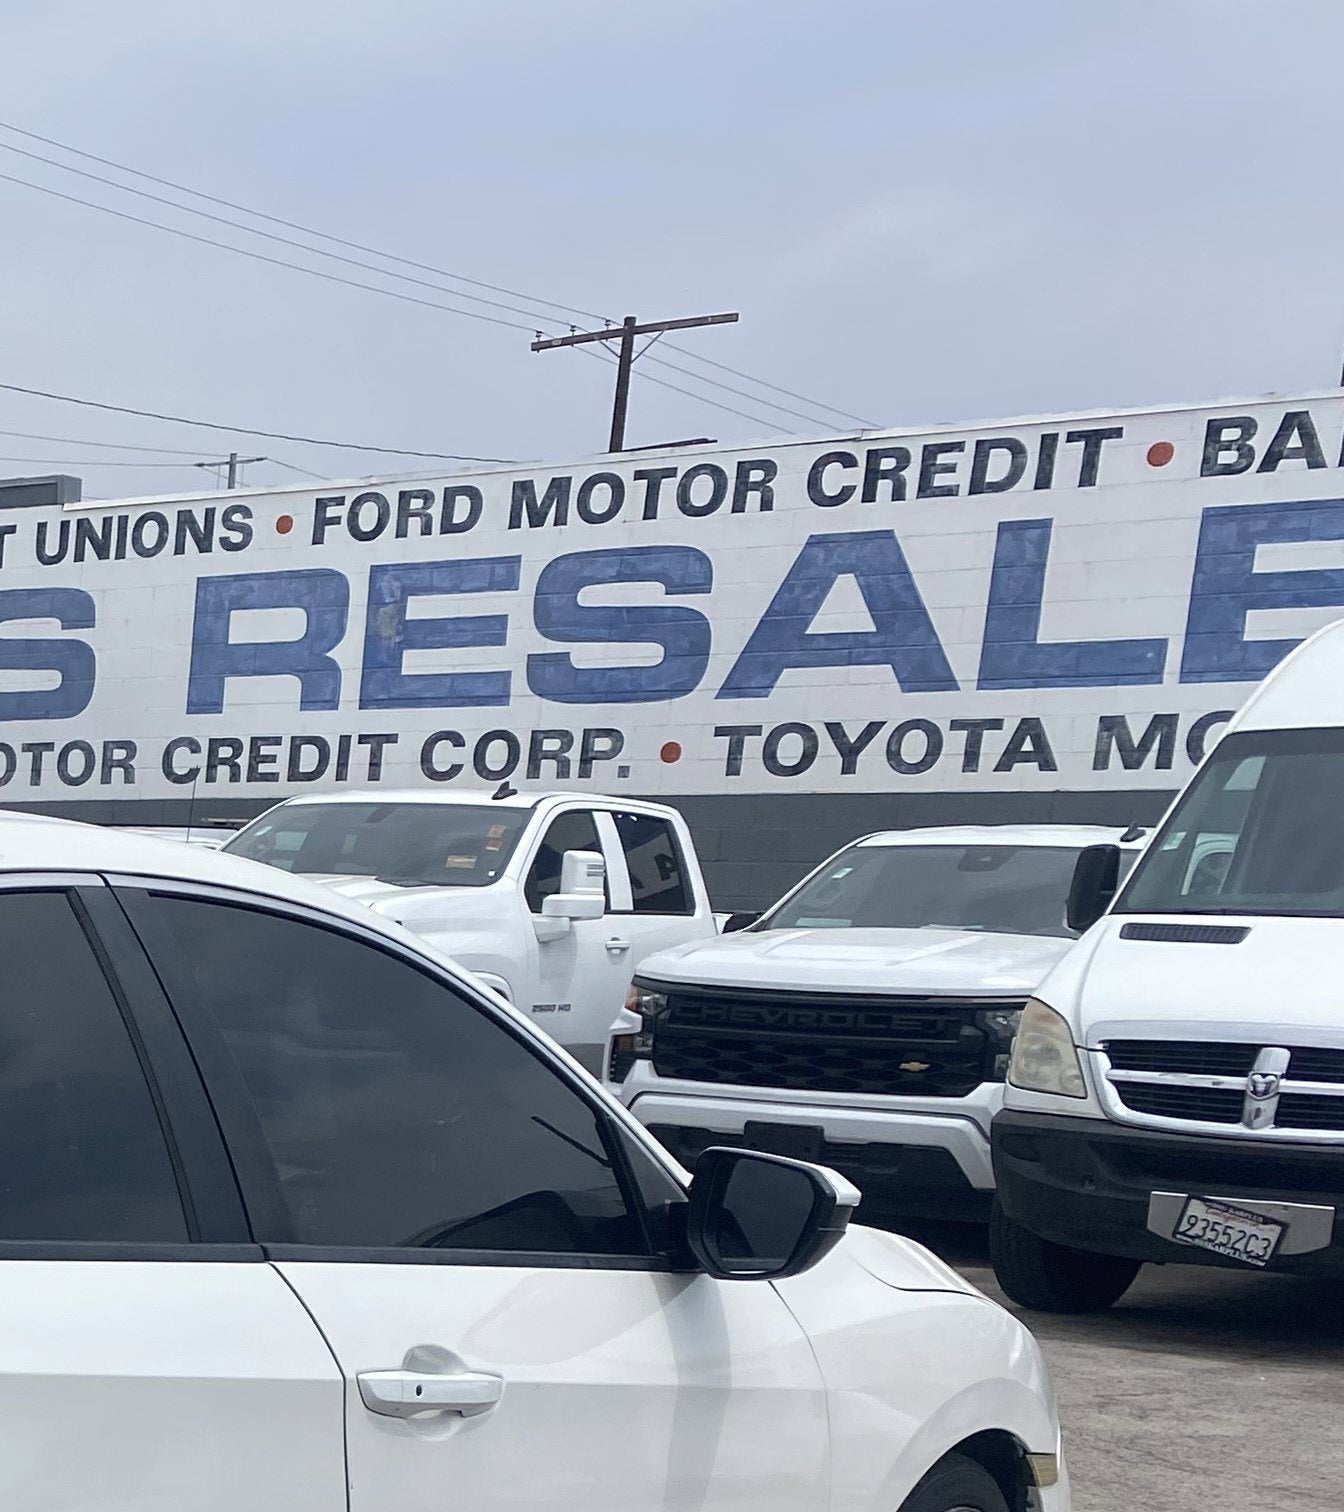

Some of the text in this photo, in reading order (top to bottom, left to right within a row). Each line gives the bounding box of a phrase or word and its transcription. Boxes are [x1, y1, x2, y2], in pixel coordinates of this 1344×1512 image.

[1200, 410, 1344, 478] BA
[311, 426, 1124, 546] FORD MOTOR CREDIT
[34, 503, 254, 565] UNIONS
[161, 733, 398, 785] CREDIT
[419, 727, 631, 782] CORP.
[713, 717, 1058, 777] TOYOTA
[1181, 1214, 1272, 1259] 93552C3
